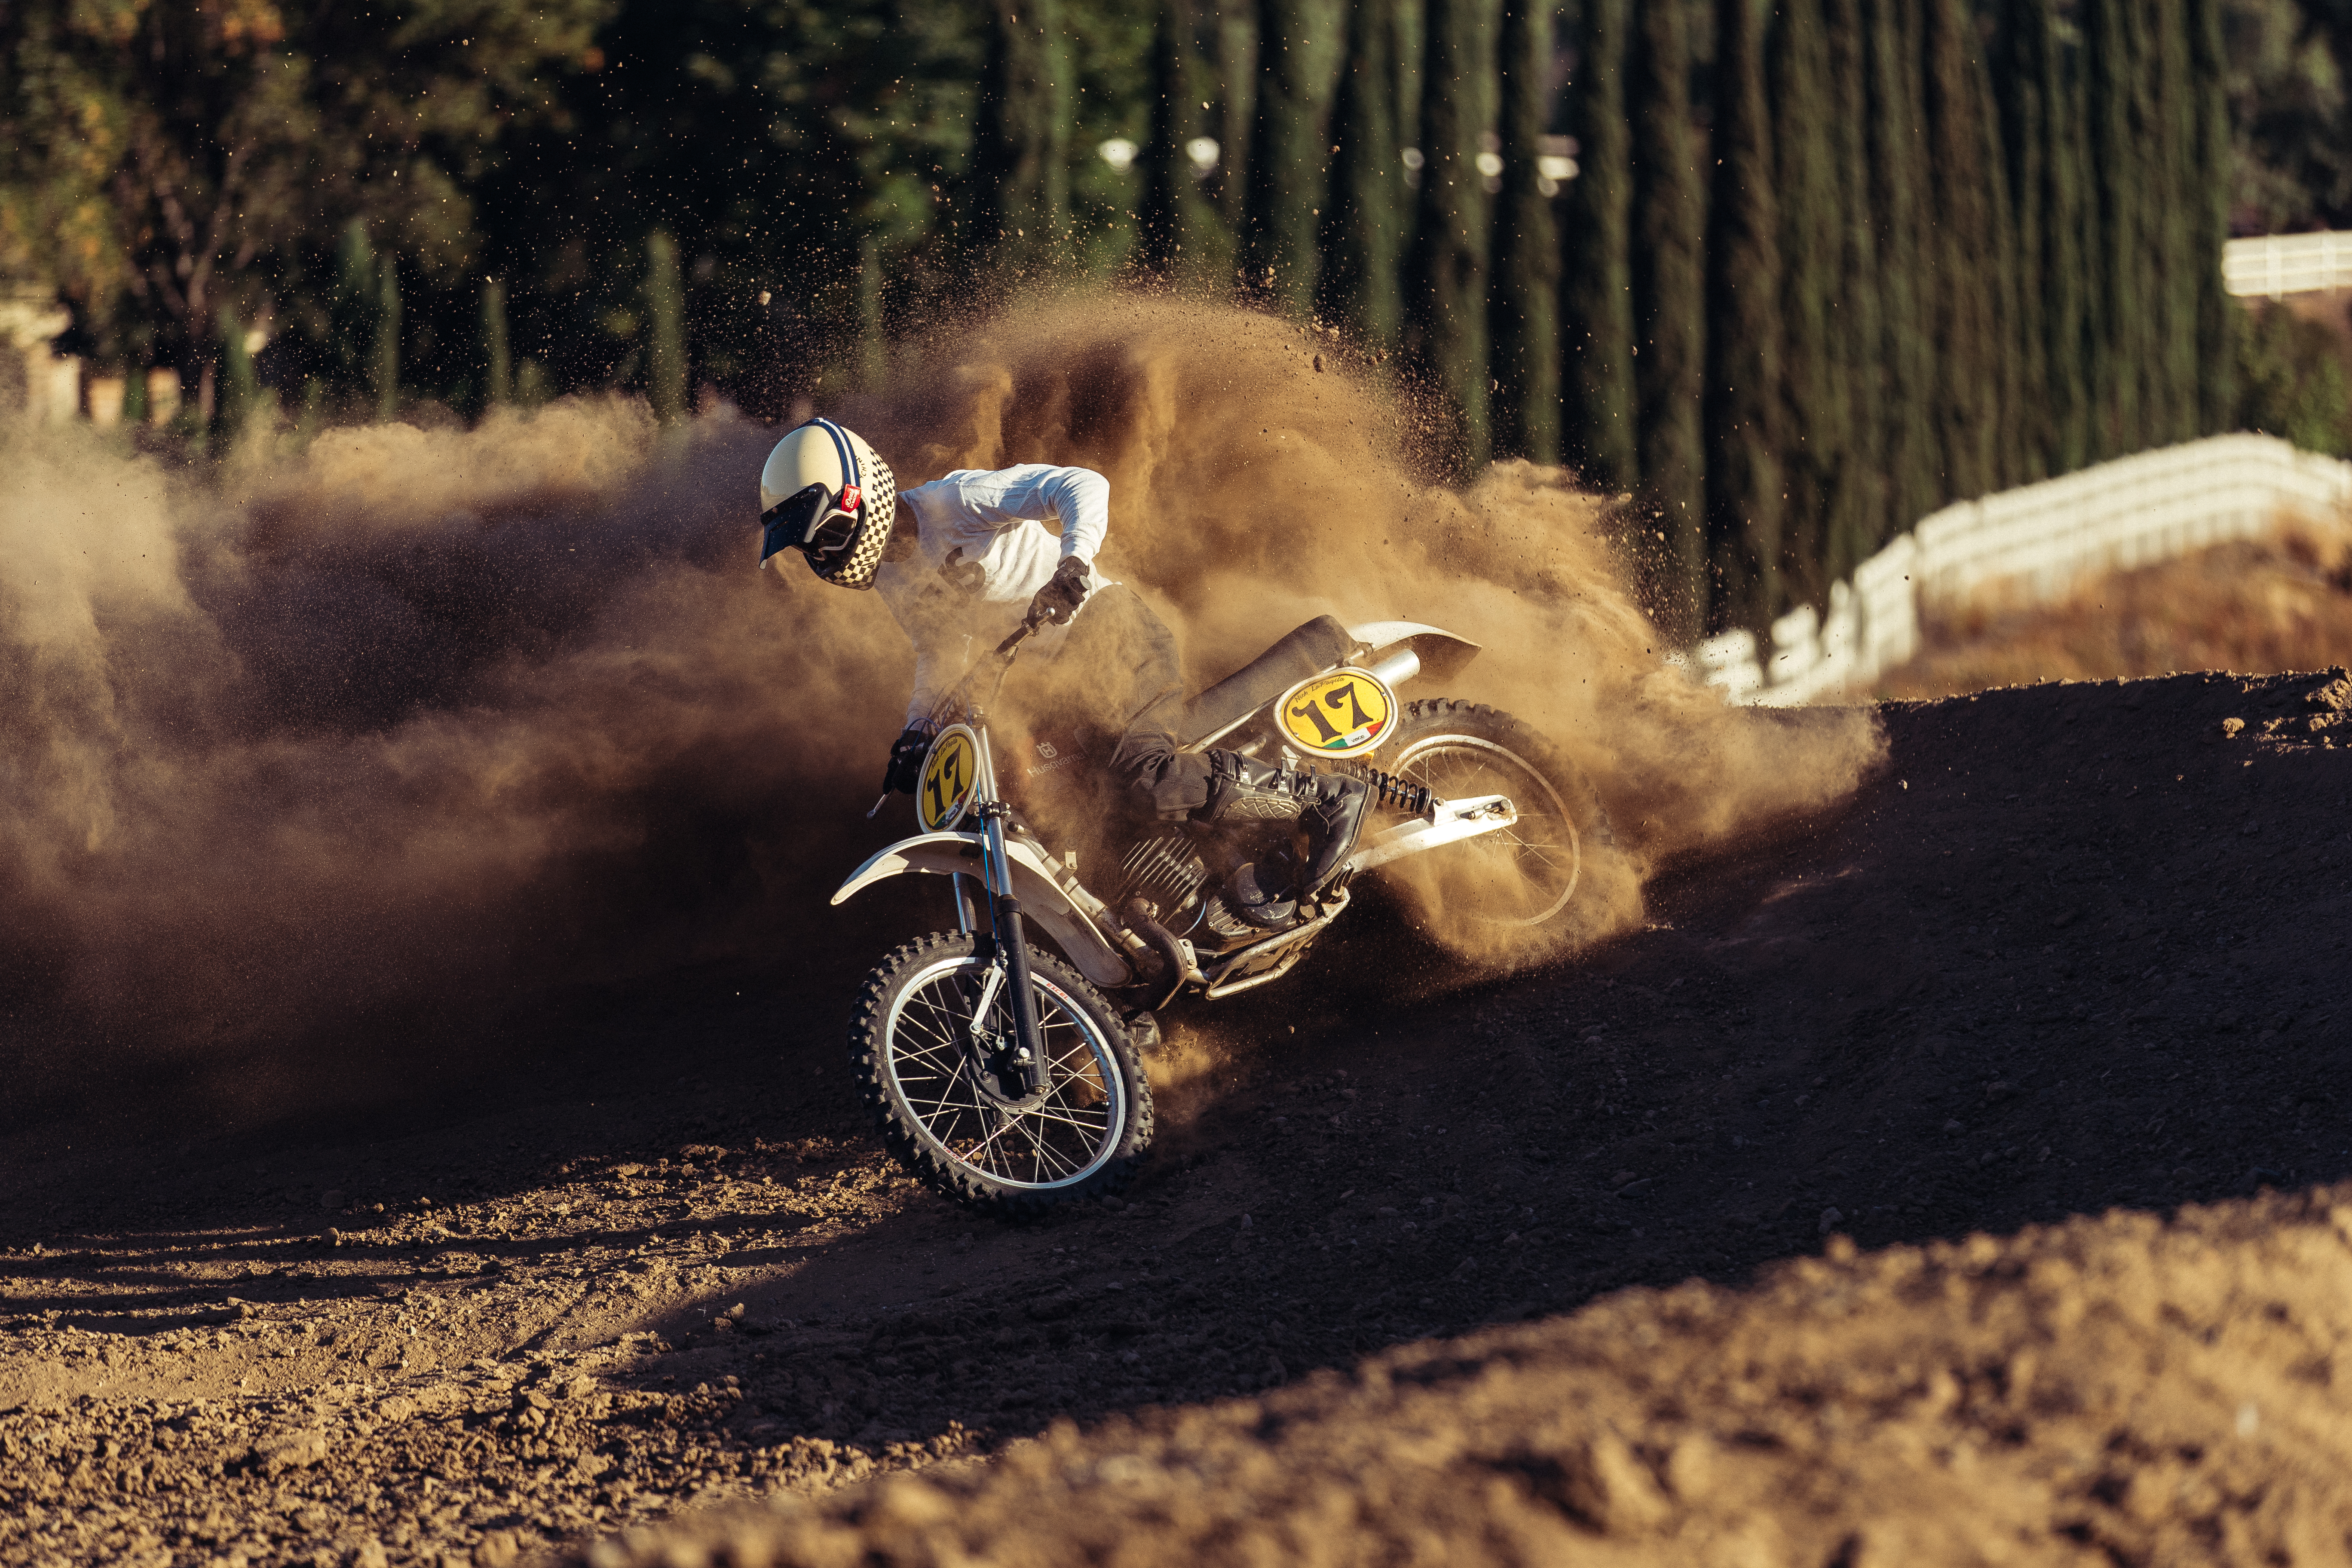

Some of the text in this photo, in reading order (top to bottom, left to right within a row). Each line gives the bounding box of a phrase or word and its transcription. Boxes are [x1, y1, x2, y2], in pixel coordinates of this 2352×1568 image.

[1292, 682, 1373, 743] 17
[1027, 753, 1084, 778] Husqvarna
[927, 743, 964, 822] 17
[1046, 983, 1069, 1001] EXCEL
[943, 1146, 965, 1163] EXCEL
